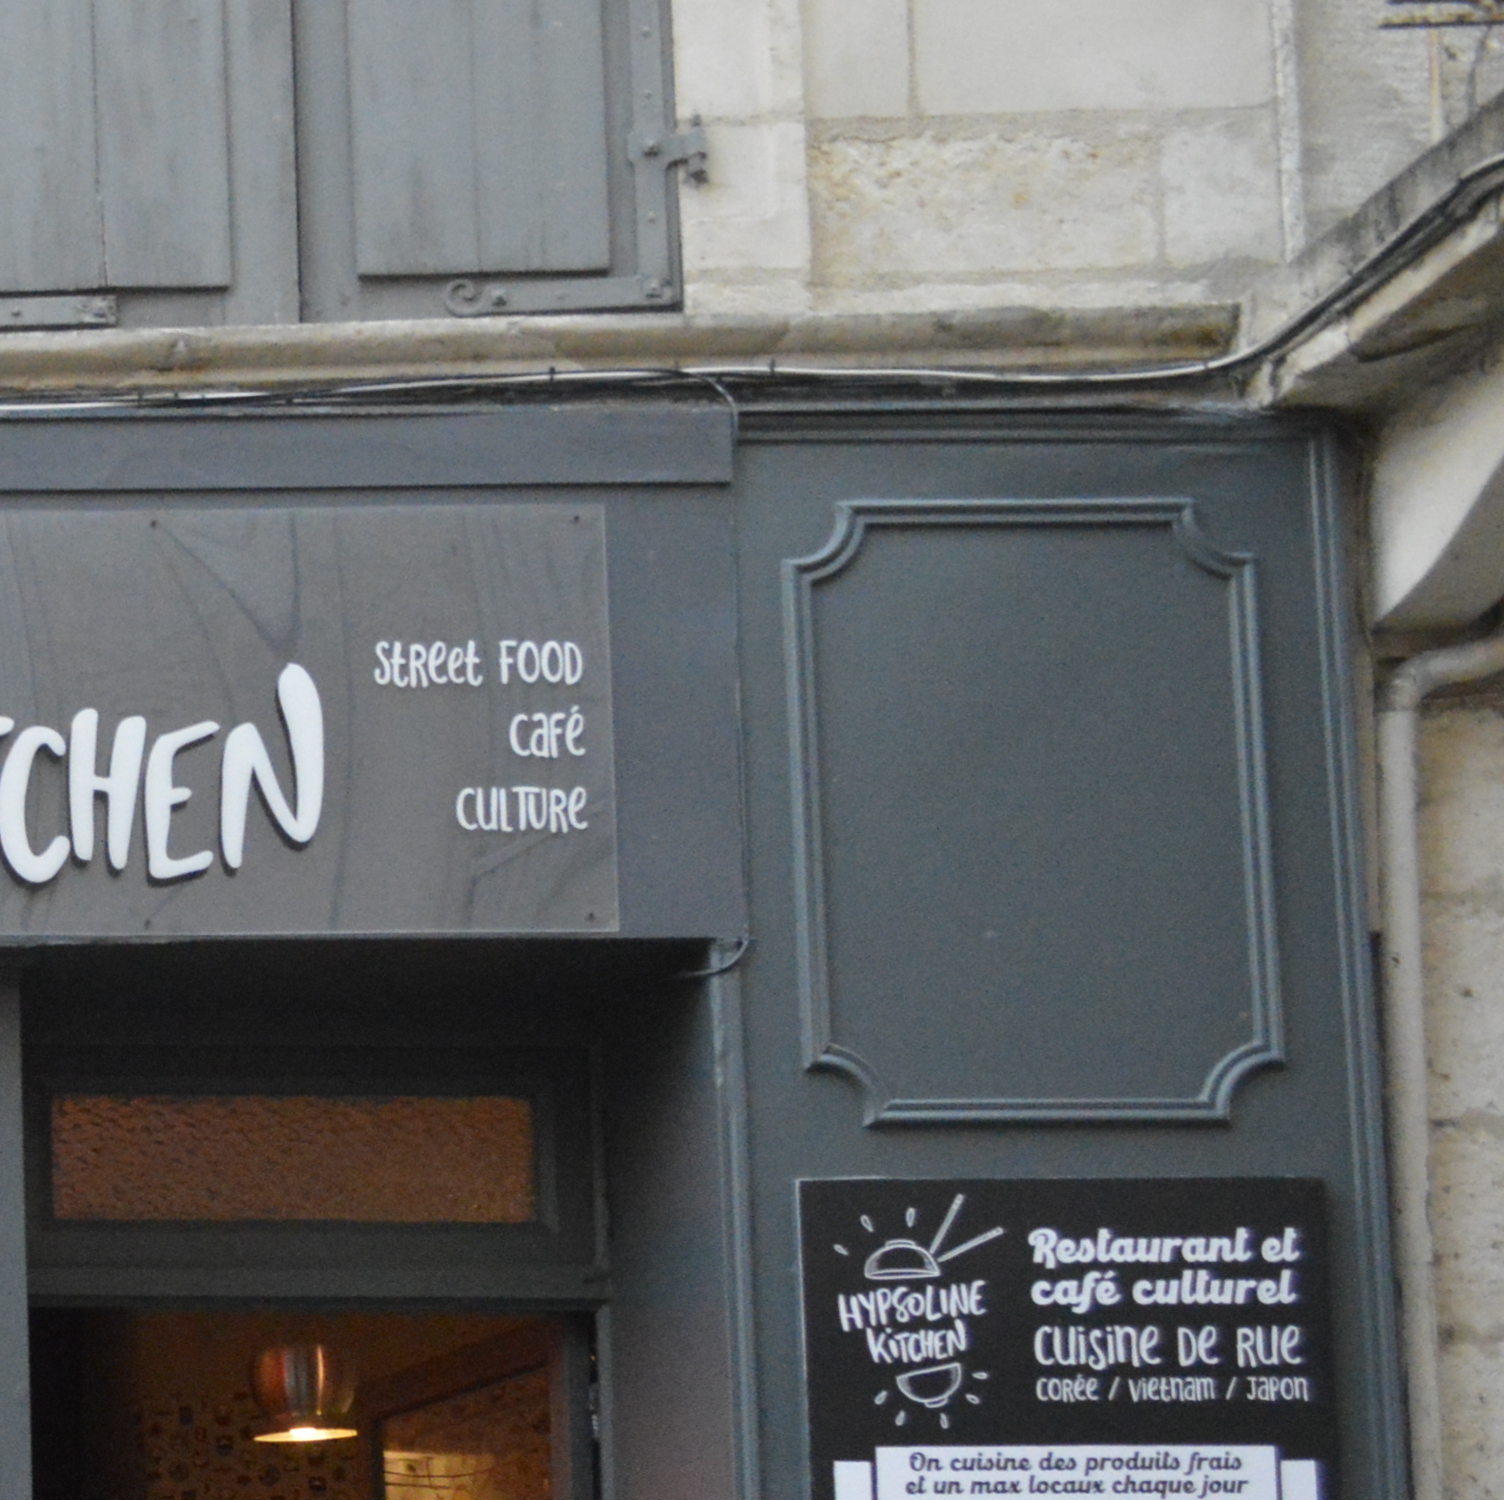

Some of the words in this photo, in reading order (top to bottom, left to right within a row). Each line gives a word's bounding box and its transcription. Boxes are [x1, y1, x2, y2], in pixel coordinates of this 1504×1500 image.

[498, 640, 584, 685] FOOD
[1027, 1227, 1252, 1269] Restaurant
[1261, 1227, 1300, 1262] et
[838, 1279, 987, 1332] HYPSOLINE
[1031, 1270, 1122, 1314] café
[1132, 1269, 1297, 1305] culturel
[909, 1452, 943, 1471] On
[950, 1453, 1032, 1471] cuisine
[1039, 1452, 1077, 1471] des
[1084, 1452, 1180, 1476] produits
[1185, 1452, 1243, 1476] frais
[905, 1475, 927, 1494] et
[933, 1479, 963, 1494] un
[970, 1478, 1021, 1494] max
[1028, 1475, 1105, 1494] locaux
[1112, 1475, 1195, 1499] chaque
[1198, 1475, 1249, 1499] jour
